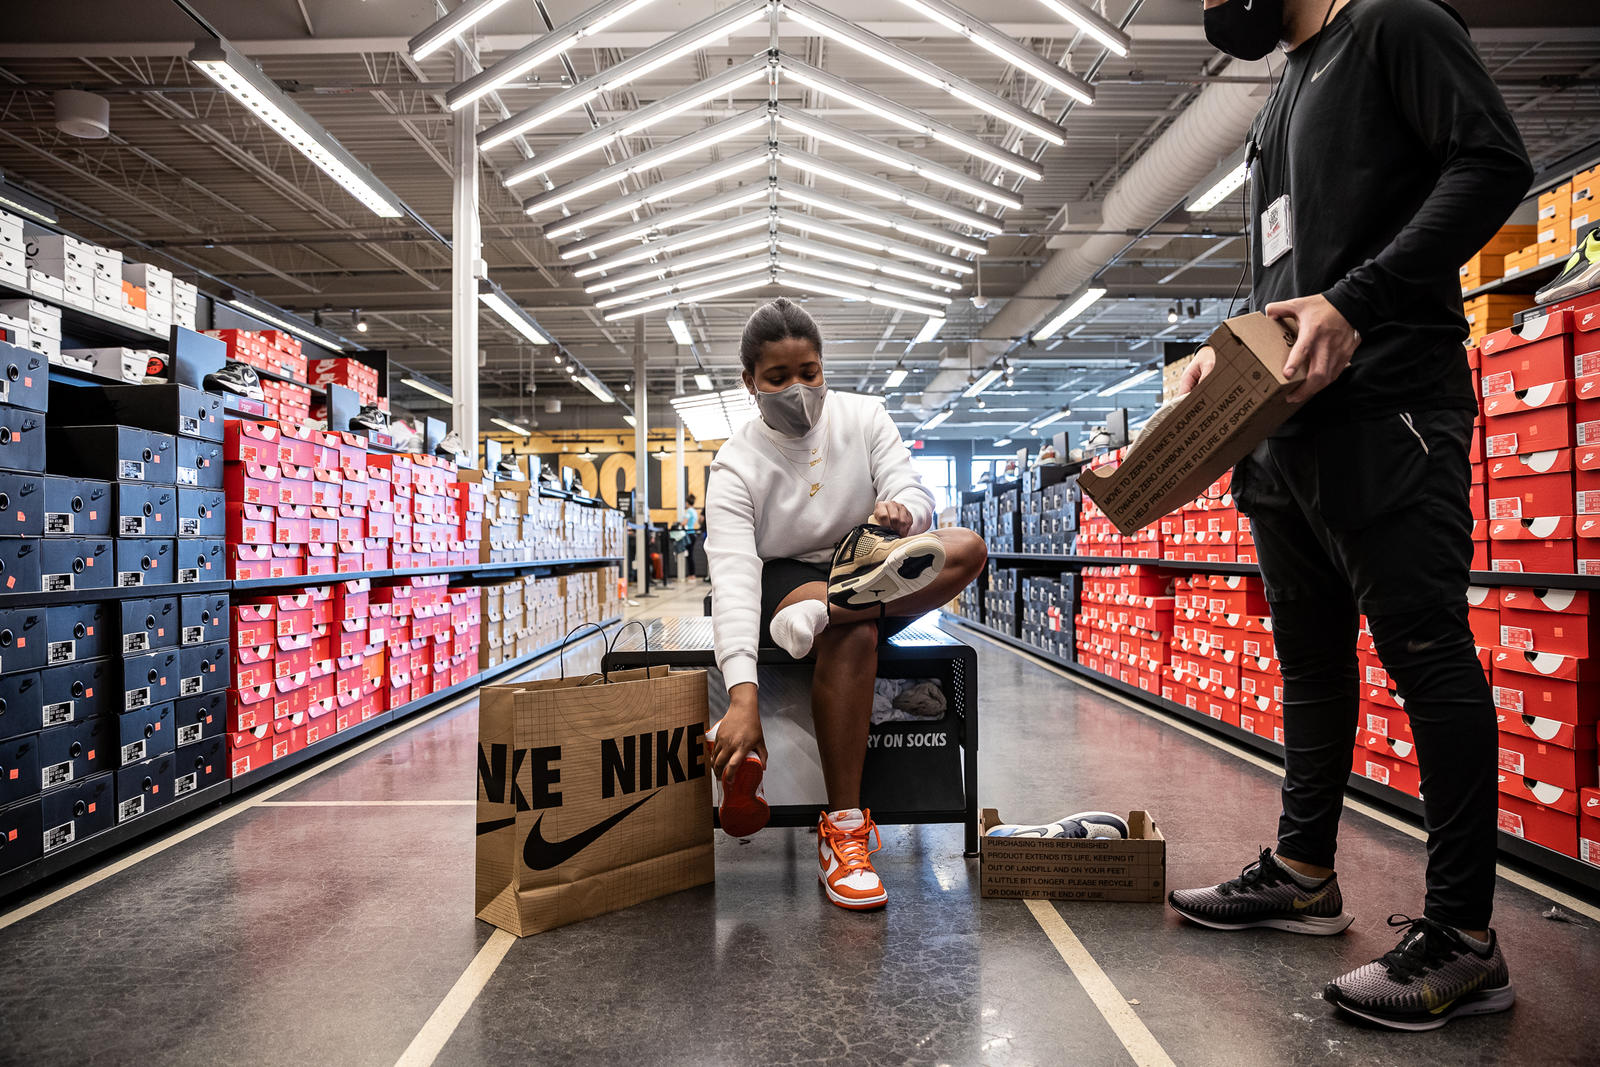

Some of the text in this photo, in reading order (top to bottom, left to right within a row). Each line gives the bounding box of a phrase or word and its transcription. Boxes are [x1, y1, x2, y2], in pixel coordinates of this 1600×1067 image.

[1104, 398, 1207, 506] MOVE TO ZERO IS NIKE'S JOURNEY
[1114, 384, 1246, 517] TOWARD ZERO CARBON AND ZERO WASTE
[1124, 518, 1136, 529] TO
[1133, 502, 1150, 520] HELP
[1149, 473, 1180, 505] PROTECT
[1178, 460, 1194, 476] THE
[1191, 433, 1221, 462] FUTURE
[1218, 422, 1231, 436] OF
[601, 722, 706, 800] NIKE
[884, 734, 903, 748] ON
[906, 732, 948, 748] SOCKS
[988, 840, 1036, 848] PURCHASING
